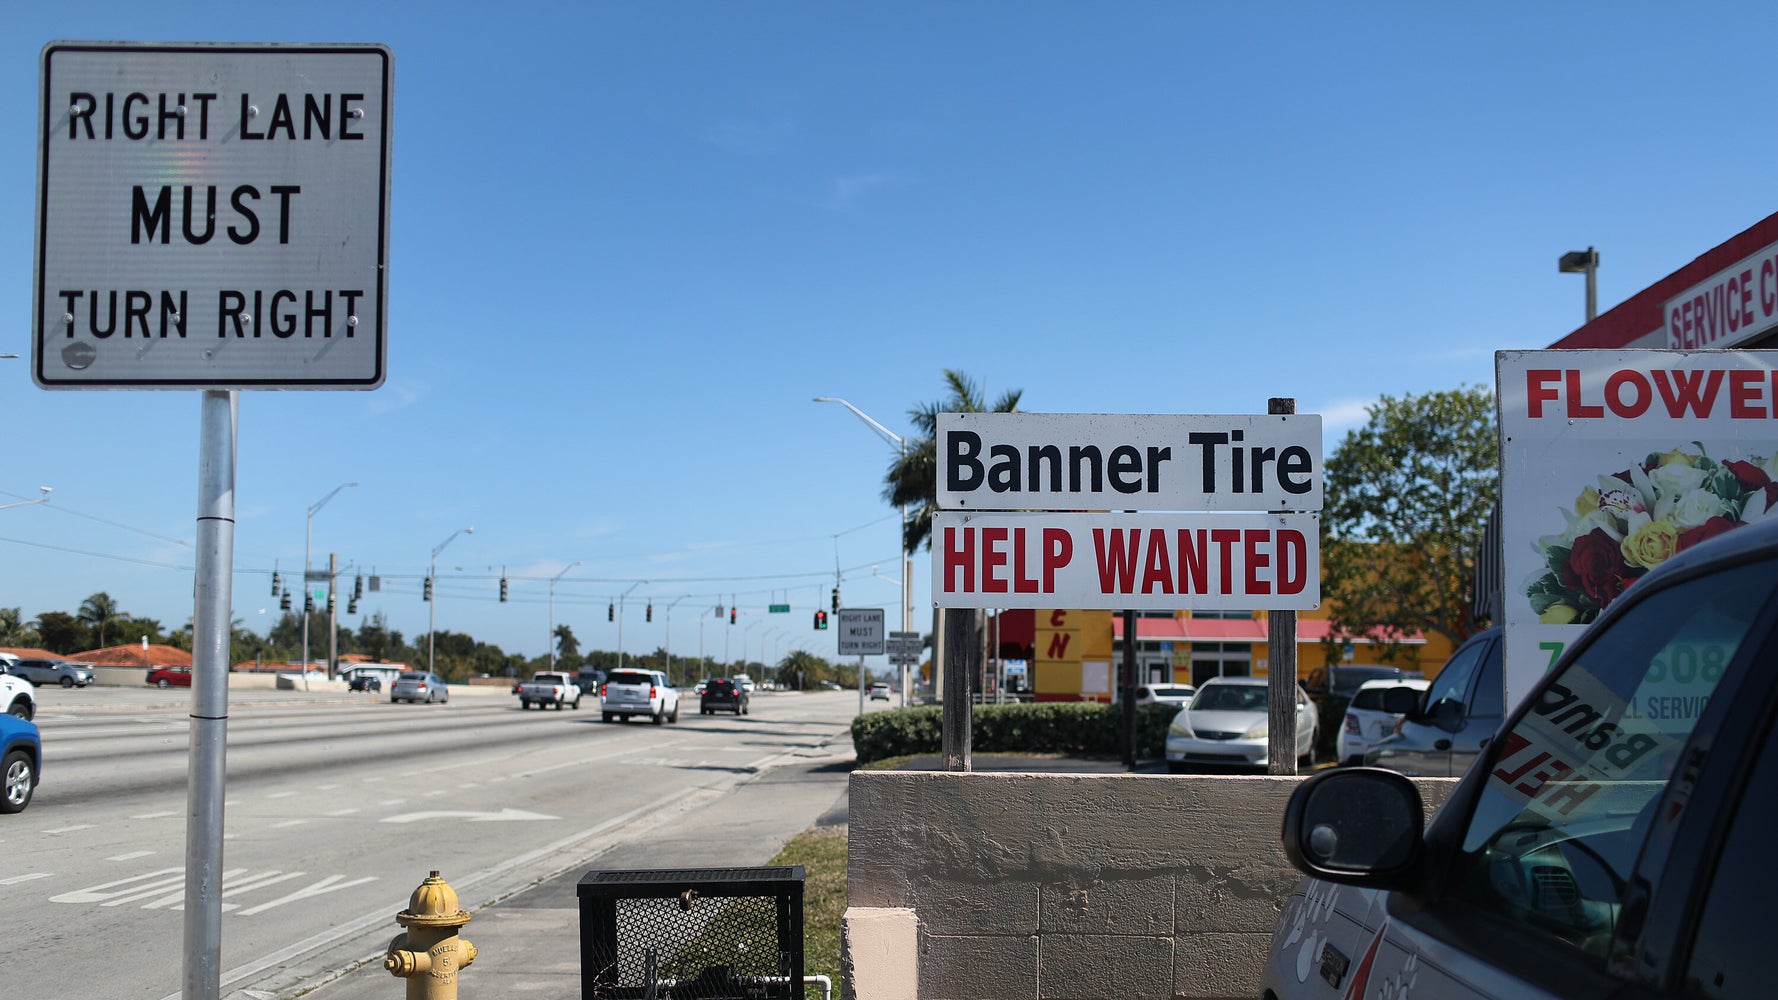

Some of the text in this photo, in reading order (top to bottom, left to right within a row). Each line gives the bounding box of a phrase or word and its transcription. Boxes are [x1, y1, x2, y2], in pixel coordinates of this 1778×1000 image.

[68, 92, 364, 141] RIGHT LANE
[130, 185, 301, 245] MUST
[59, 290, 363, 339] TURN RIGHT
[1670, 252, 1778, 350] SERVICE C
[1526, 369, 1778, 419] FLOWE
[946, 429, 1313, 494] Banner Tire
[943, 527, 1308, 595] HELP WANTED
[841, 614, 881, 623] RIGHT LANE
[849, 627, 873, 637] MUST
[841, 641, 858, 649] TURN
[861, 641, 882, 649] RIGHT
